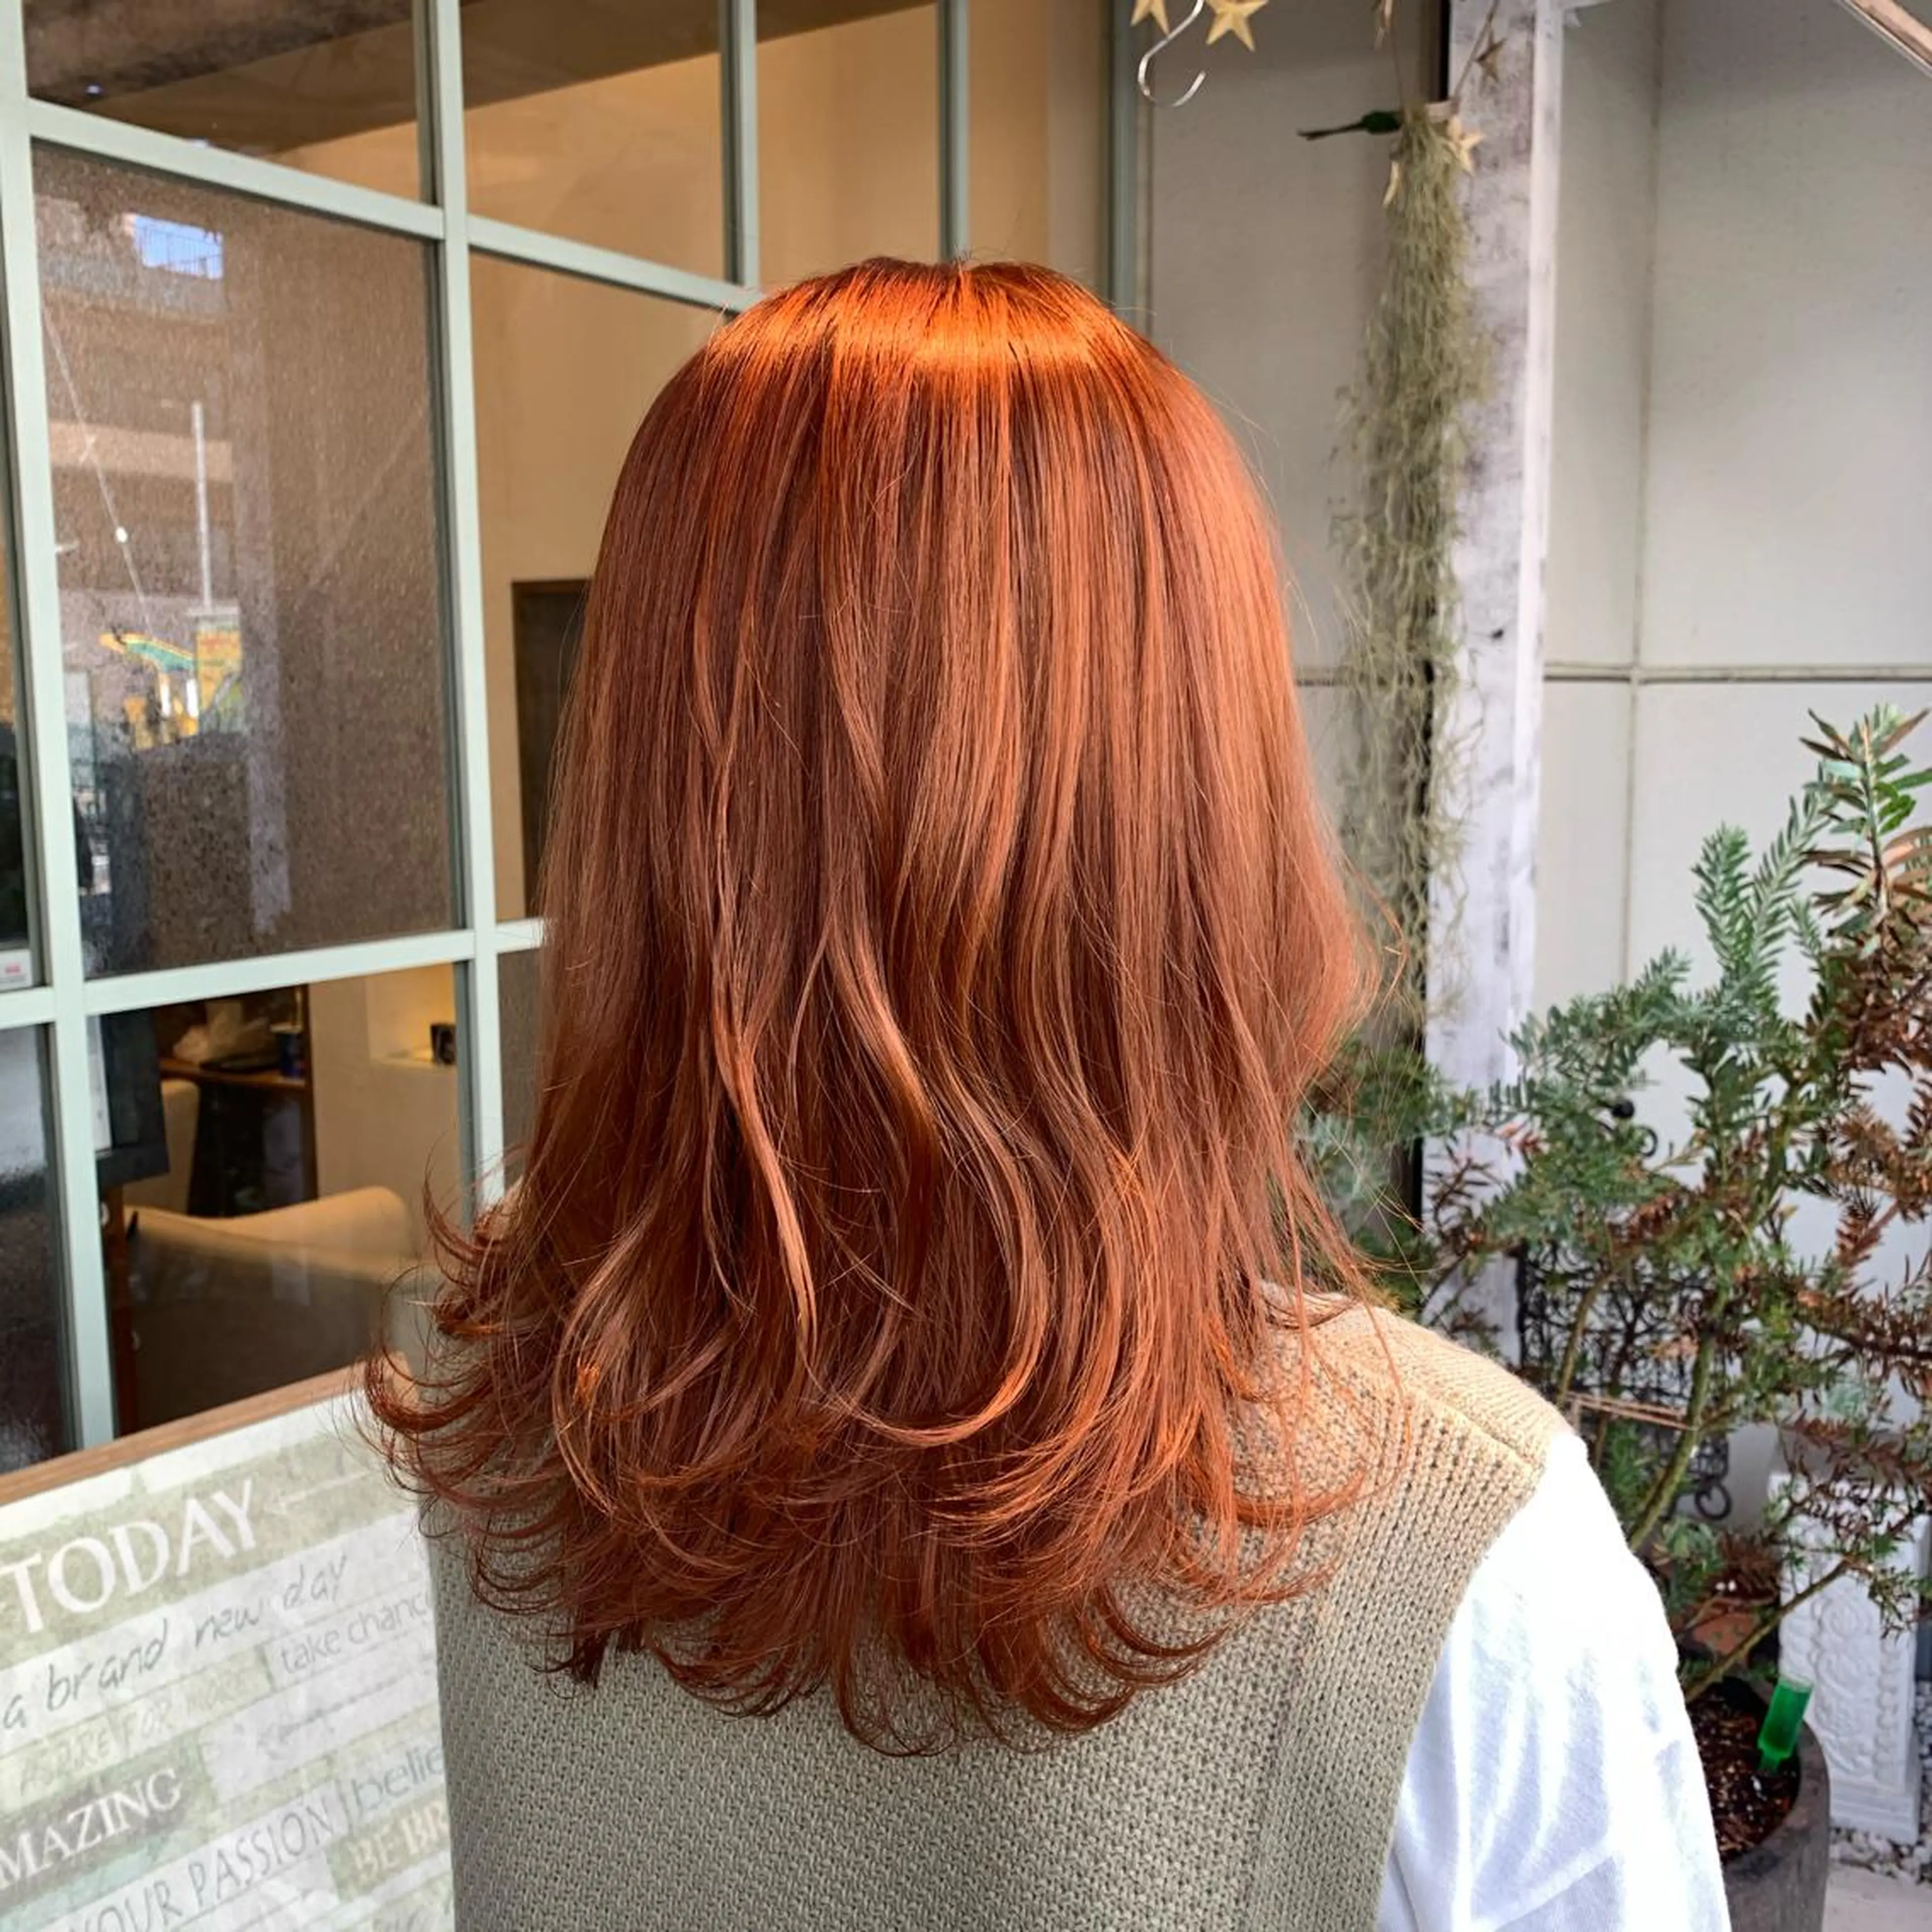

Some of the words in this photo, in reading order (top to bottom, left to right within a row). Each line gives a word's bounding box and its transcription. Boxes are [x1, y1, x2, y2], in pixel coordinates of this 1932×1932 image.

[0, 1480, 257, 1634] TODAY
[3, 1694, 27, 1729] a
[46, 1617, 169, 1712] brand
[195, 1596, 264, 1650] new
[283, 1555, 348, 1612] day
[279, 1629, 342, 1674] take
[347, 1589, 431, 1645] chanc
[188, 1795, 335, 1908] PASSION
